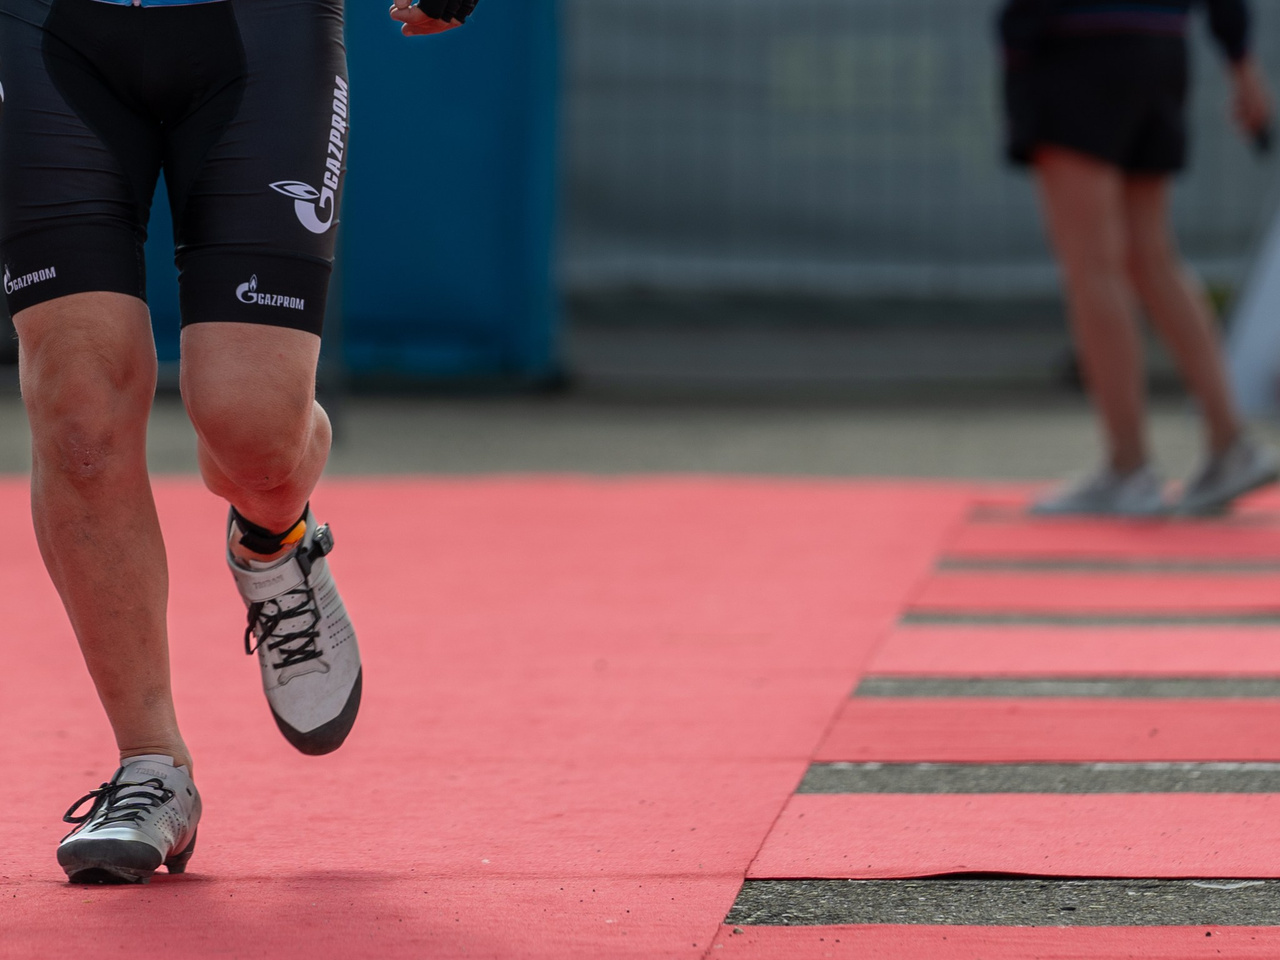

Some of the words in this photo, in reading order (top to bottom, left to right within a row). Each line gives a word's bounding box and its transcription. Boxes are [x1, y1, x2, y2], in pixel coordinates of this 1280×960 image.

[323, 74, 348, 191] GAZPROM
[13, 266, 56, 291] GAZPROM
[258, 292, 305, 311] GAZPROM
